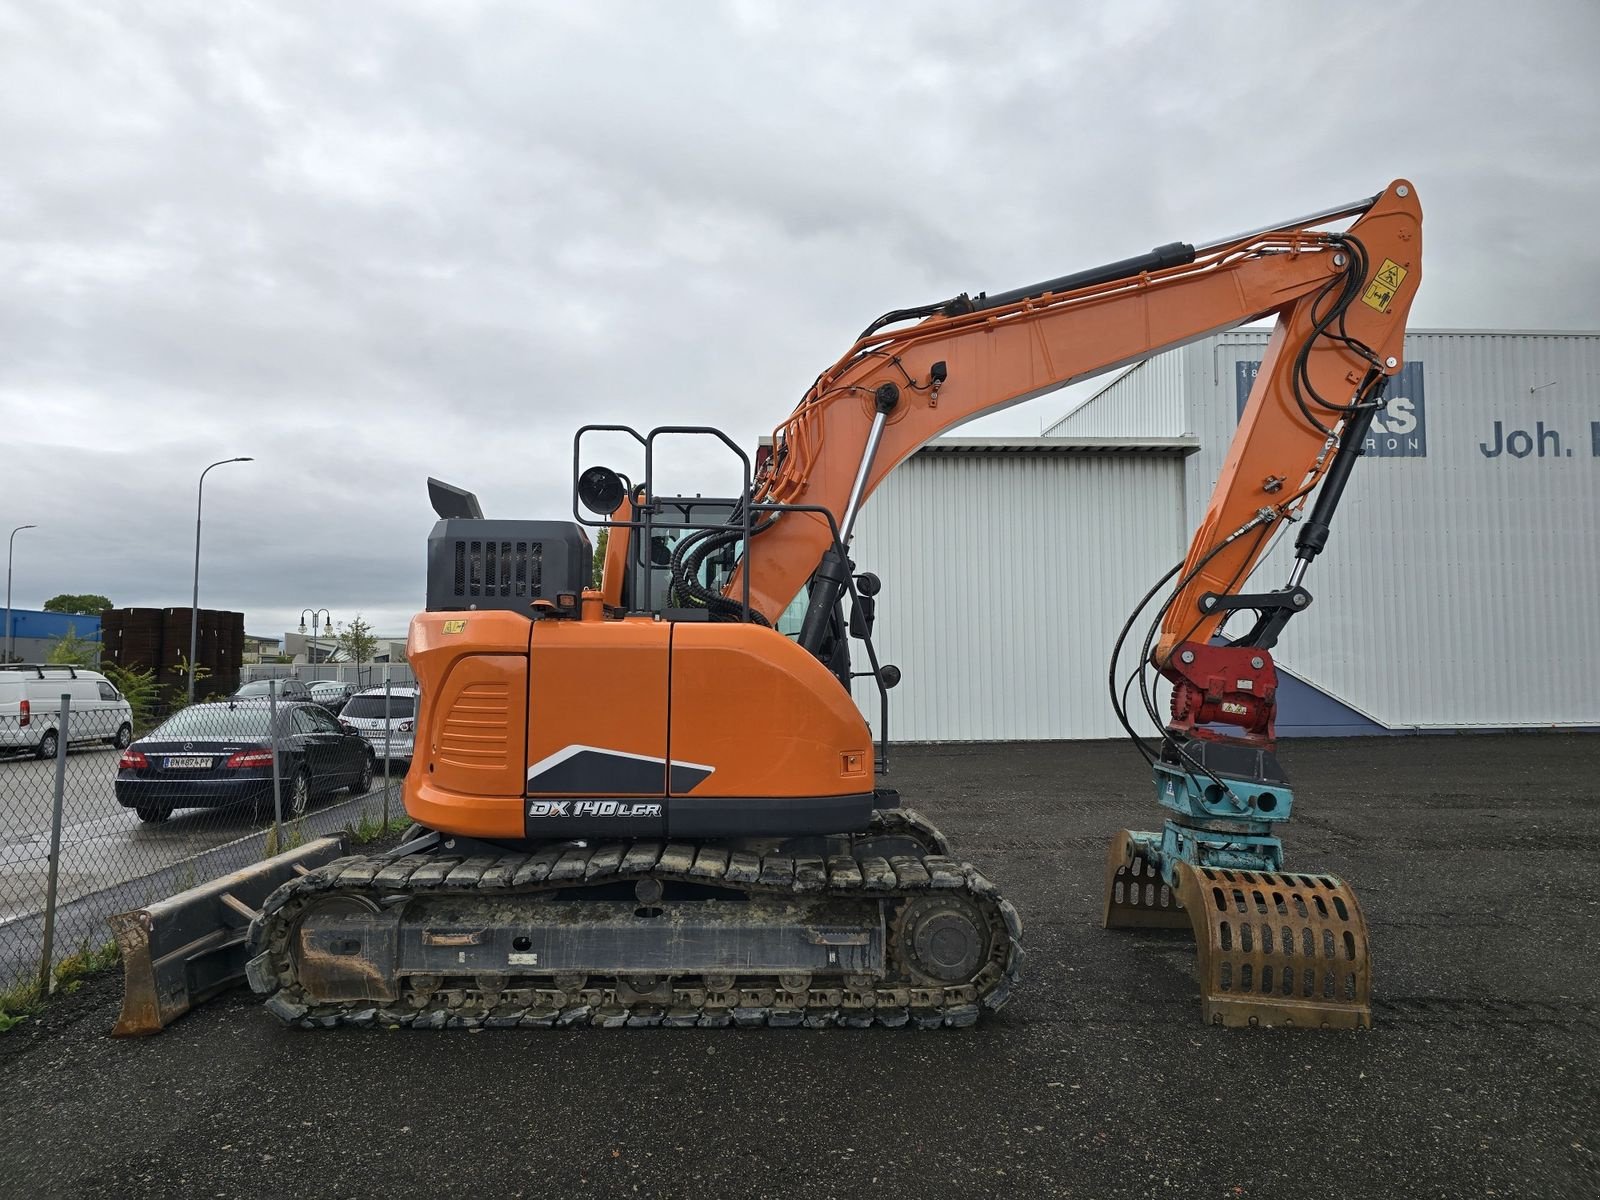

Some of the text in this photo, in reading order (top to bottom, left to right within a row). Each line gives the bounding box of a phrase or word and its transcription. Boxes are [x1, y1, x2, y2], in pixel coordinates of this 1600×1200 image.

[1241, 369, 1258, 378] 18
[1480, 421, 1572, 458] Joh.
[529, 801, 571, 818] DX
